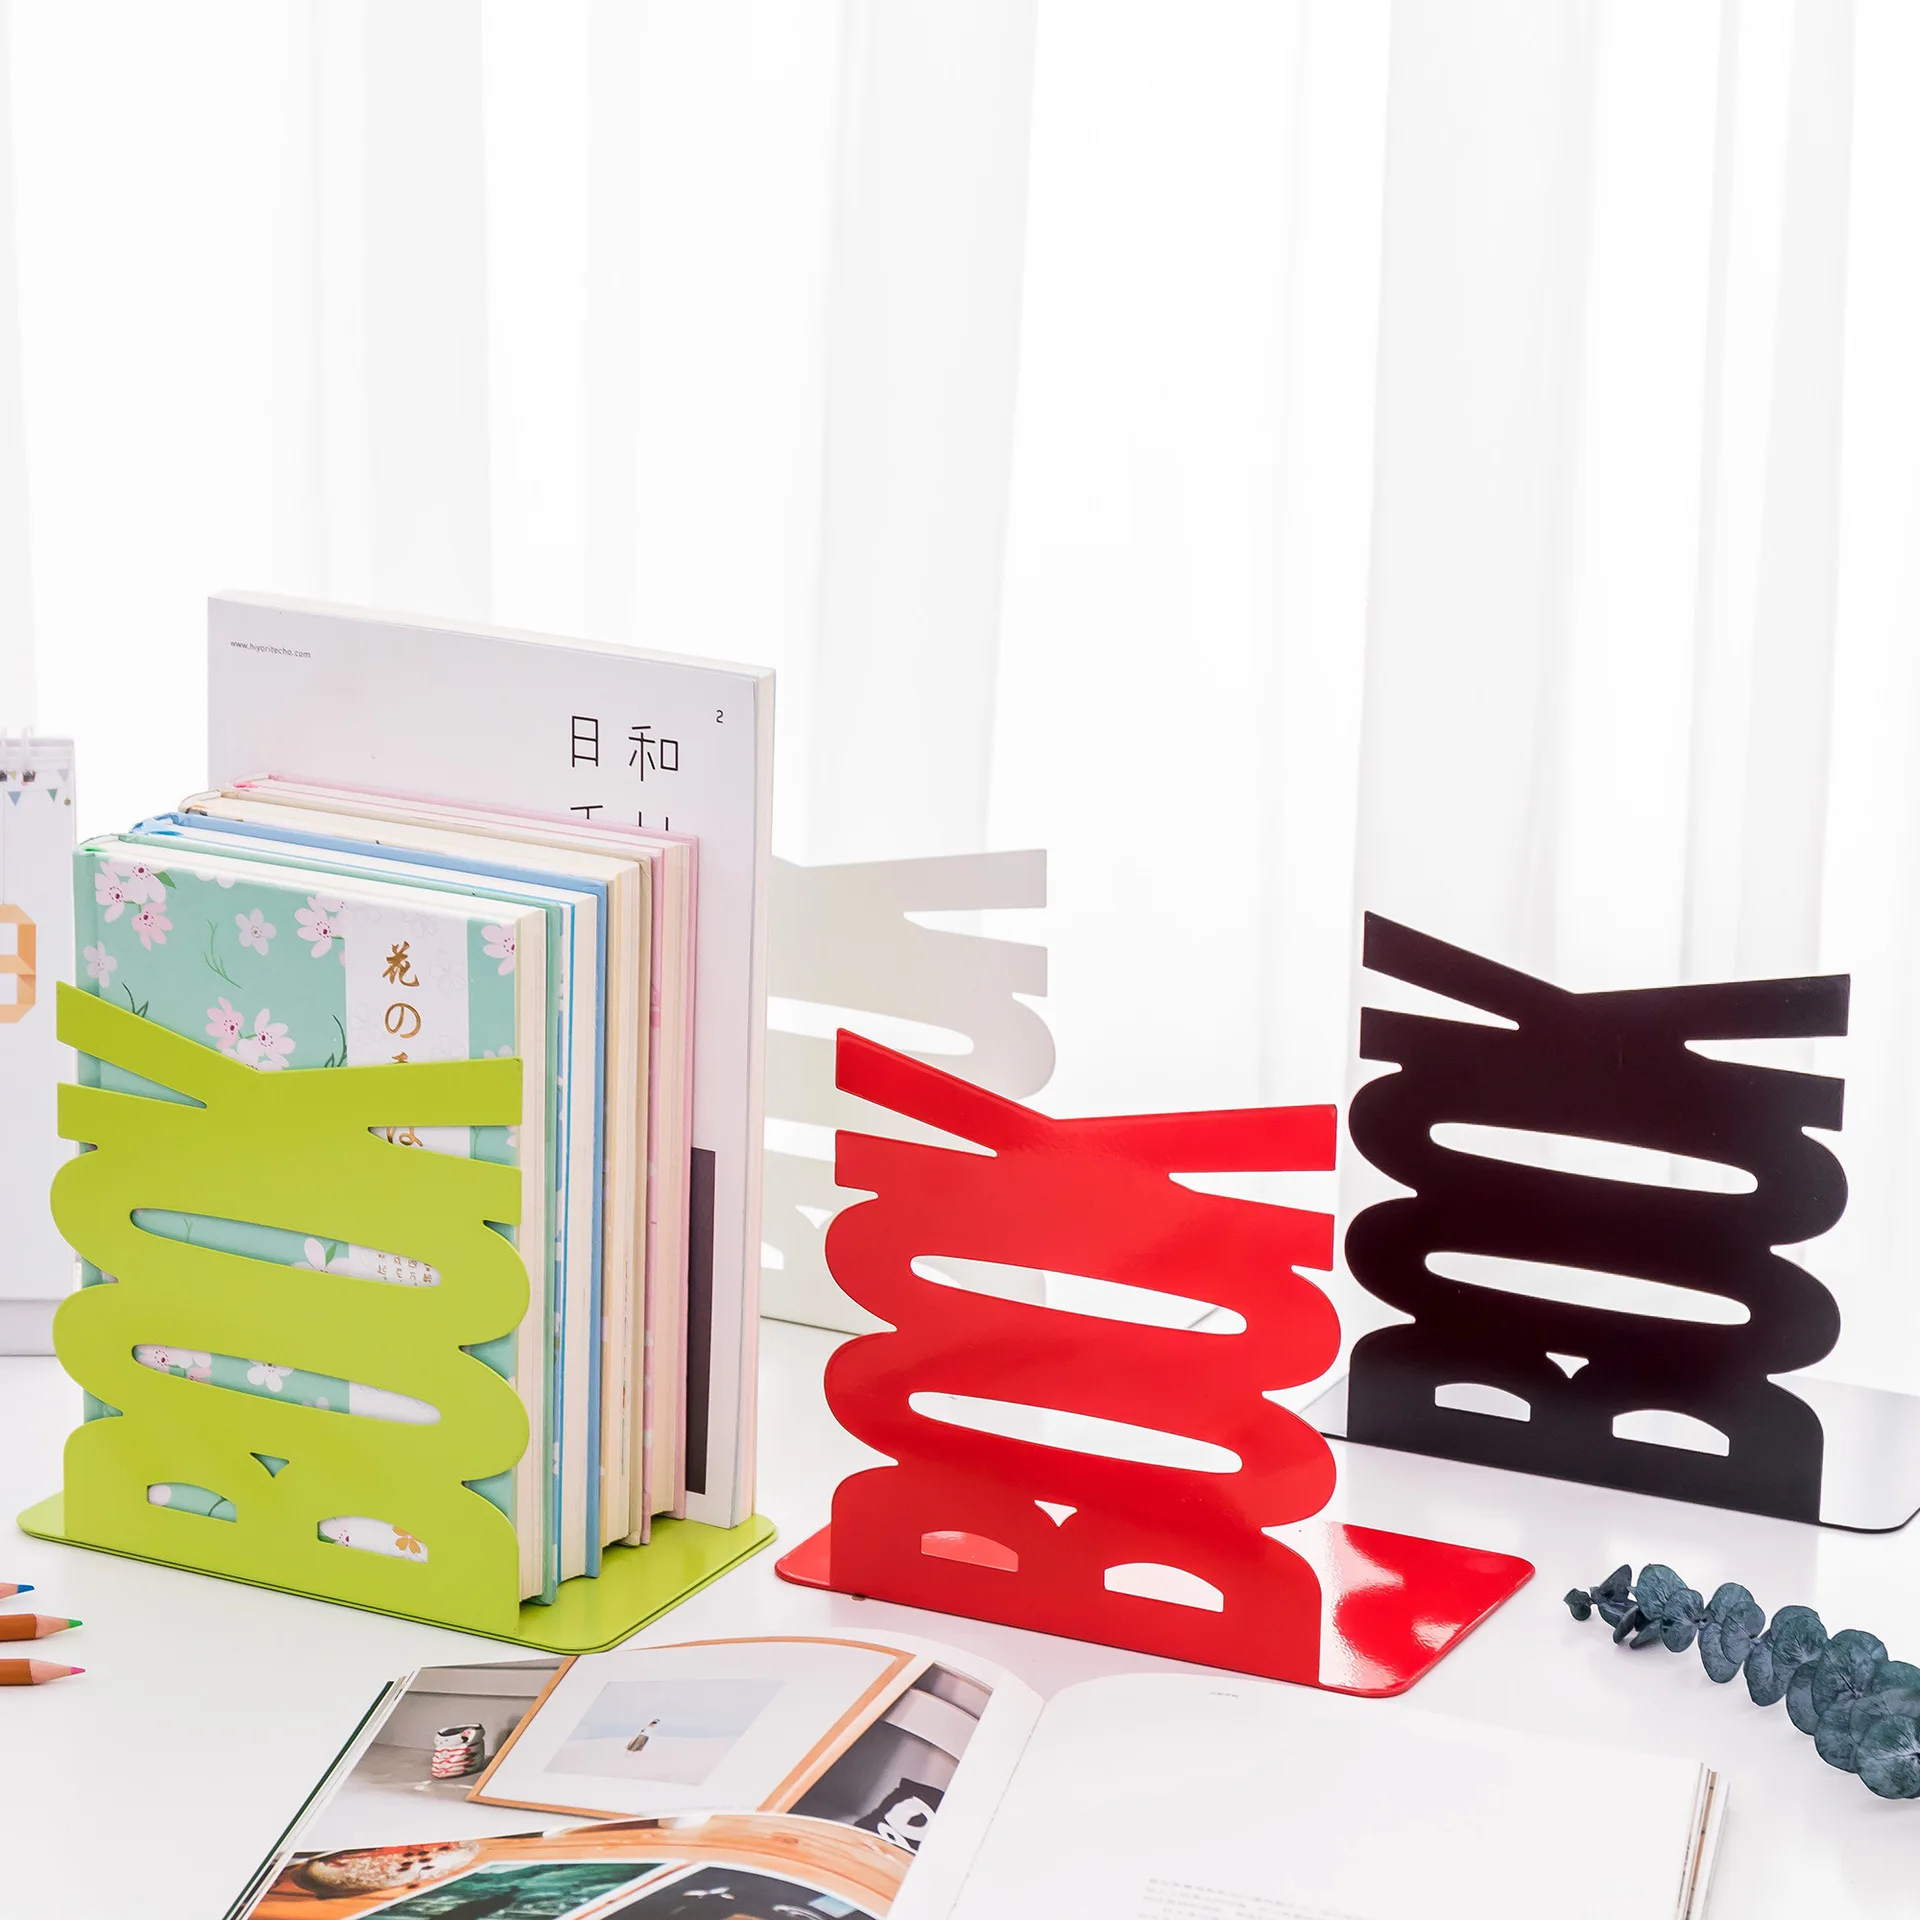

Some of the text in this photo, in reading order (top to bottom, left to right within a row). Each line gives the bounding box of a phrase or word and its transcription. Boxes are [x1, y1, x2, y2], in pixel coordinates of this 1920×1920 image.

[230, 640, 311, 658] www.hiyoritecho.com
[571, 715, 678, 782] 日和
[715, 709, 724, 724] 2
[50, 981, 531, 1637] BOOK
[824, 1027, 1341, 1685] BOOK
[1345, 910, 1852, 1523] BOOK
